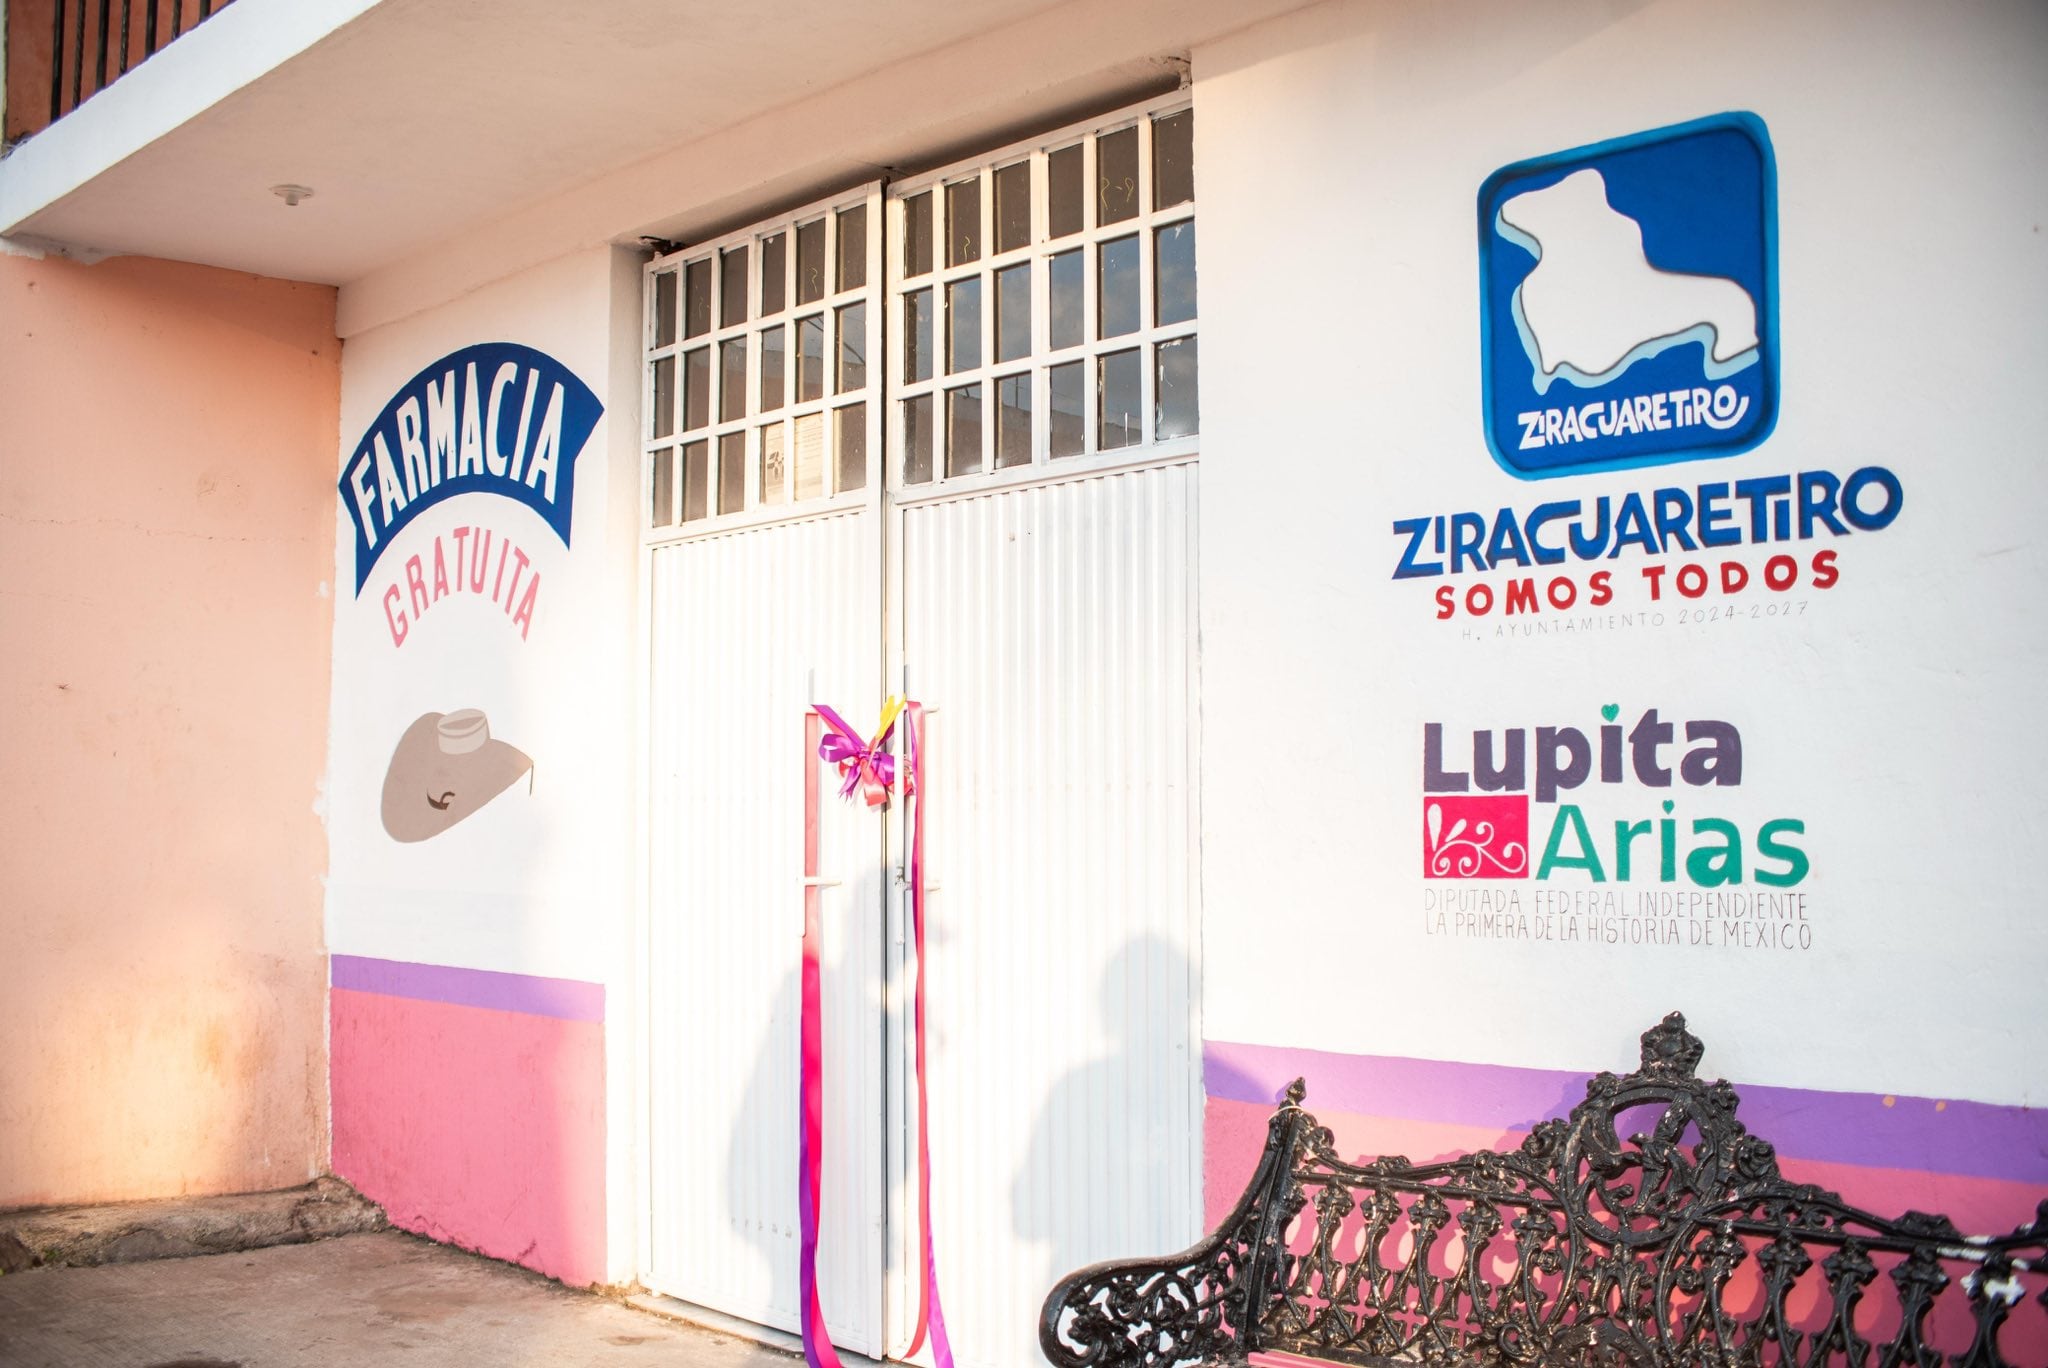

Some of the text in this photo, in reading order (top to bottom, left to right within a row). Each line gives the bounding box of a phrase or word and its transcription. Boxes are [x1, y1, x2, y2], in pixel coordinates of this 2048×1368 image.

[351, 361, 565, 550] FARMACIA
[382, 526, 541, 648] GRATUITA
[1435, 550, 1840, 620] SOMOS TODOS
[1462, 600, 1809, 641] H. AYUNTAMIENTO 2024-2027
[1423, 703, 1743, 803] Lupita
[1535, 799, 1810, 888] Arias
[1424, 888, 1809, 921] DIPUTADA FEDERAL INDEPENDIENTE
[1426, 912, 1812, 950] LA PRIMERA DE LA HISTORIA DE MEXICO
